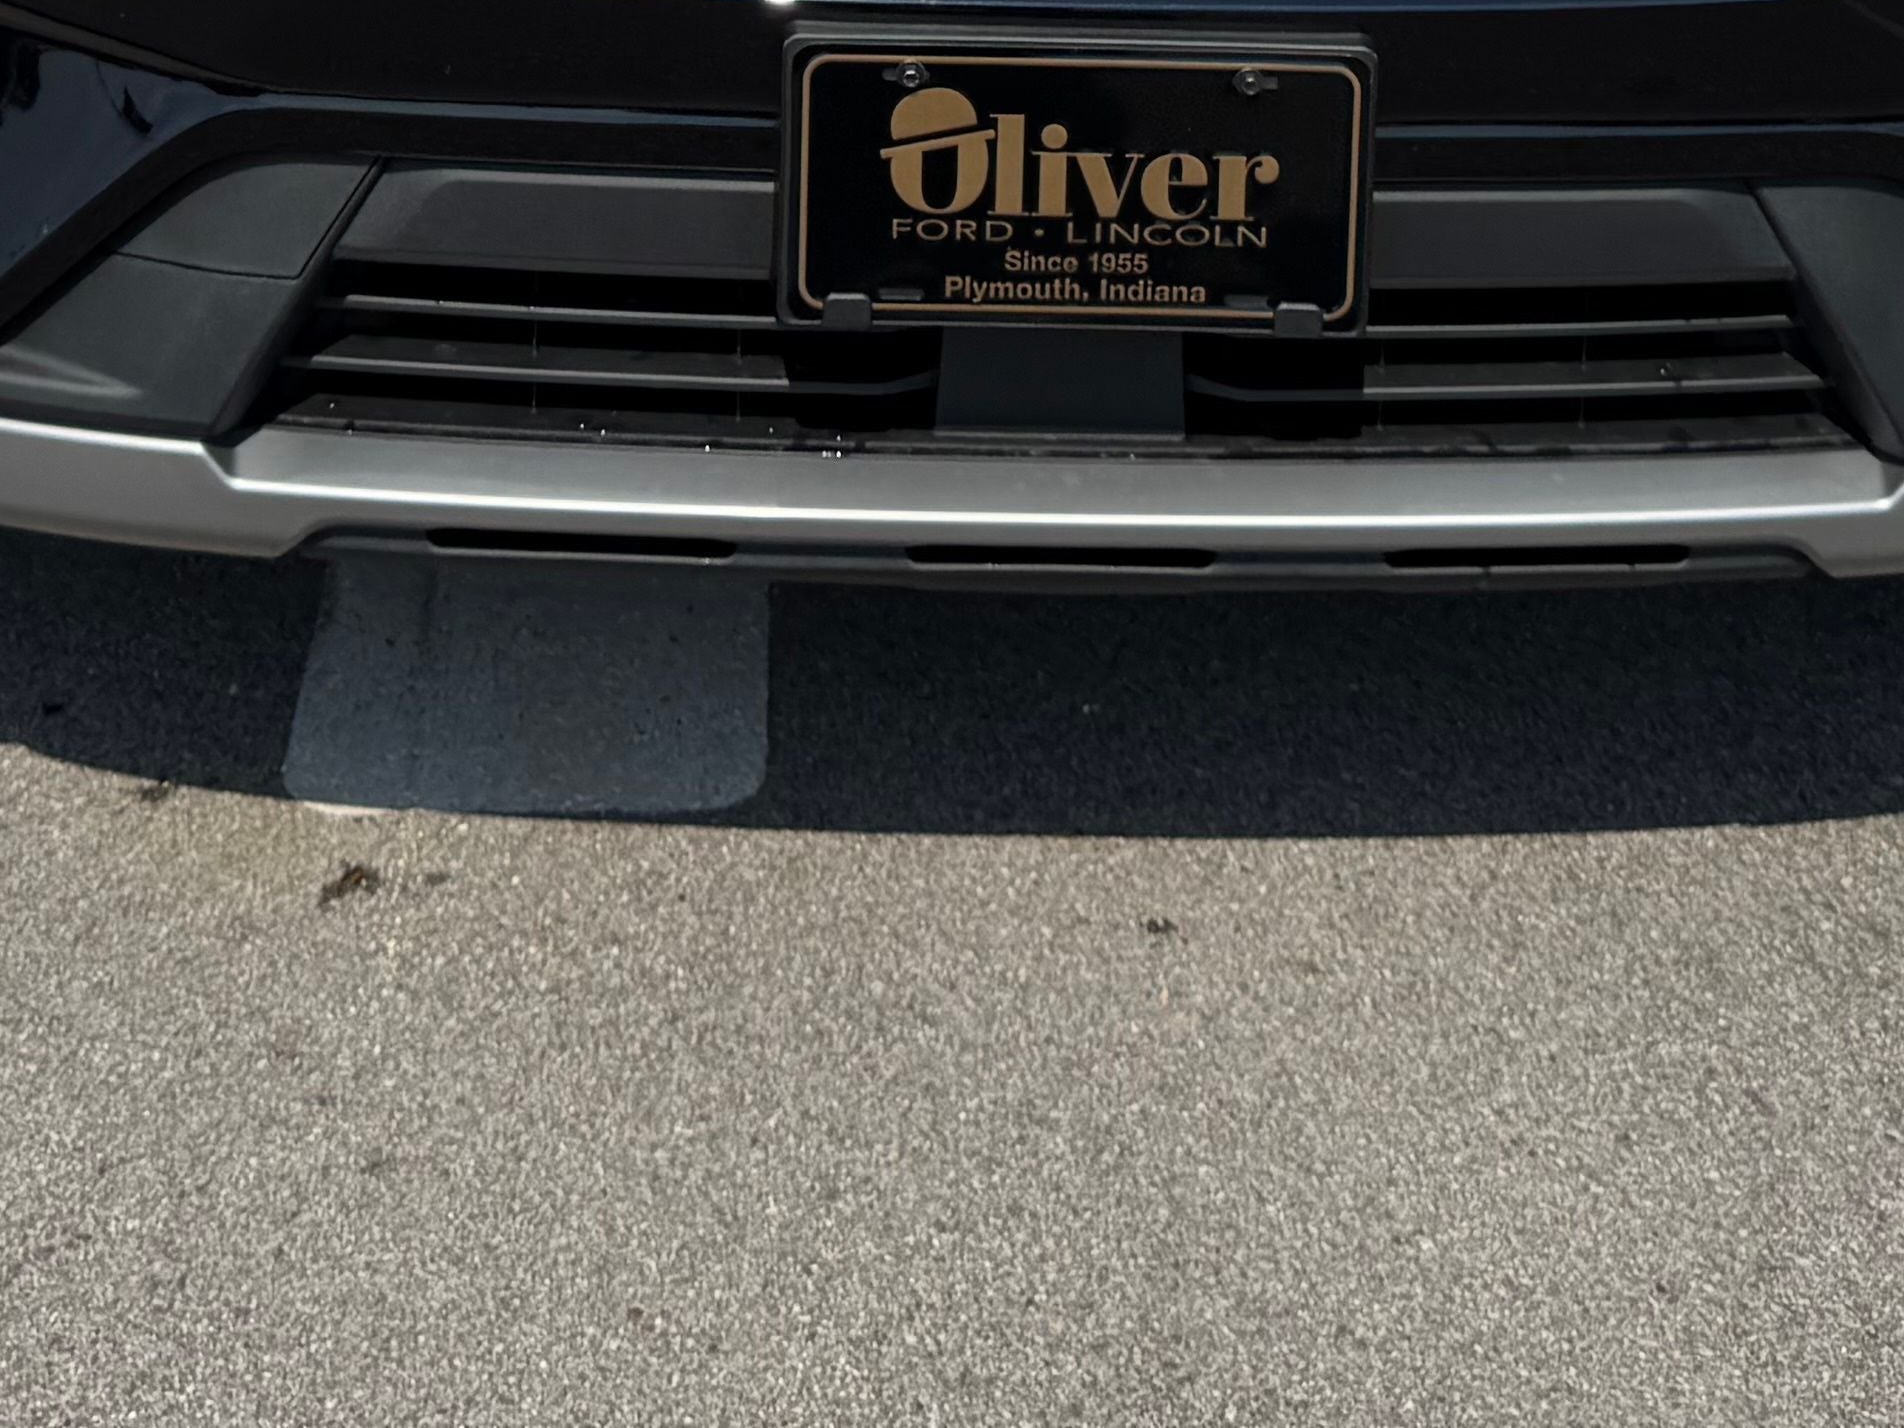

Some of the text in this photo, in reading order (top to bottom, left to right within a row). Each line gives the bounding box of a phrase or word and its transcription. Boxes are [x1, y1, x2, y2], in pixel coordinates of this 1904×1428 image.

[880, 87, 1280, 221] Oliver
[892, 218, 1268, 248] FORD LINCOLN
[1003, 250, 1149, 275] Since 1955
[944, 275, 1207, 304] Plymouth, Indiana
